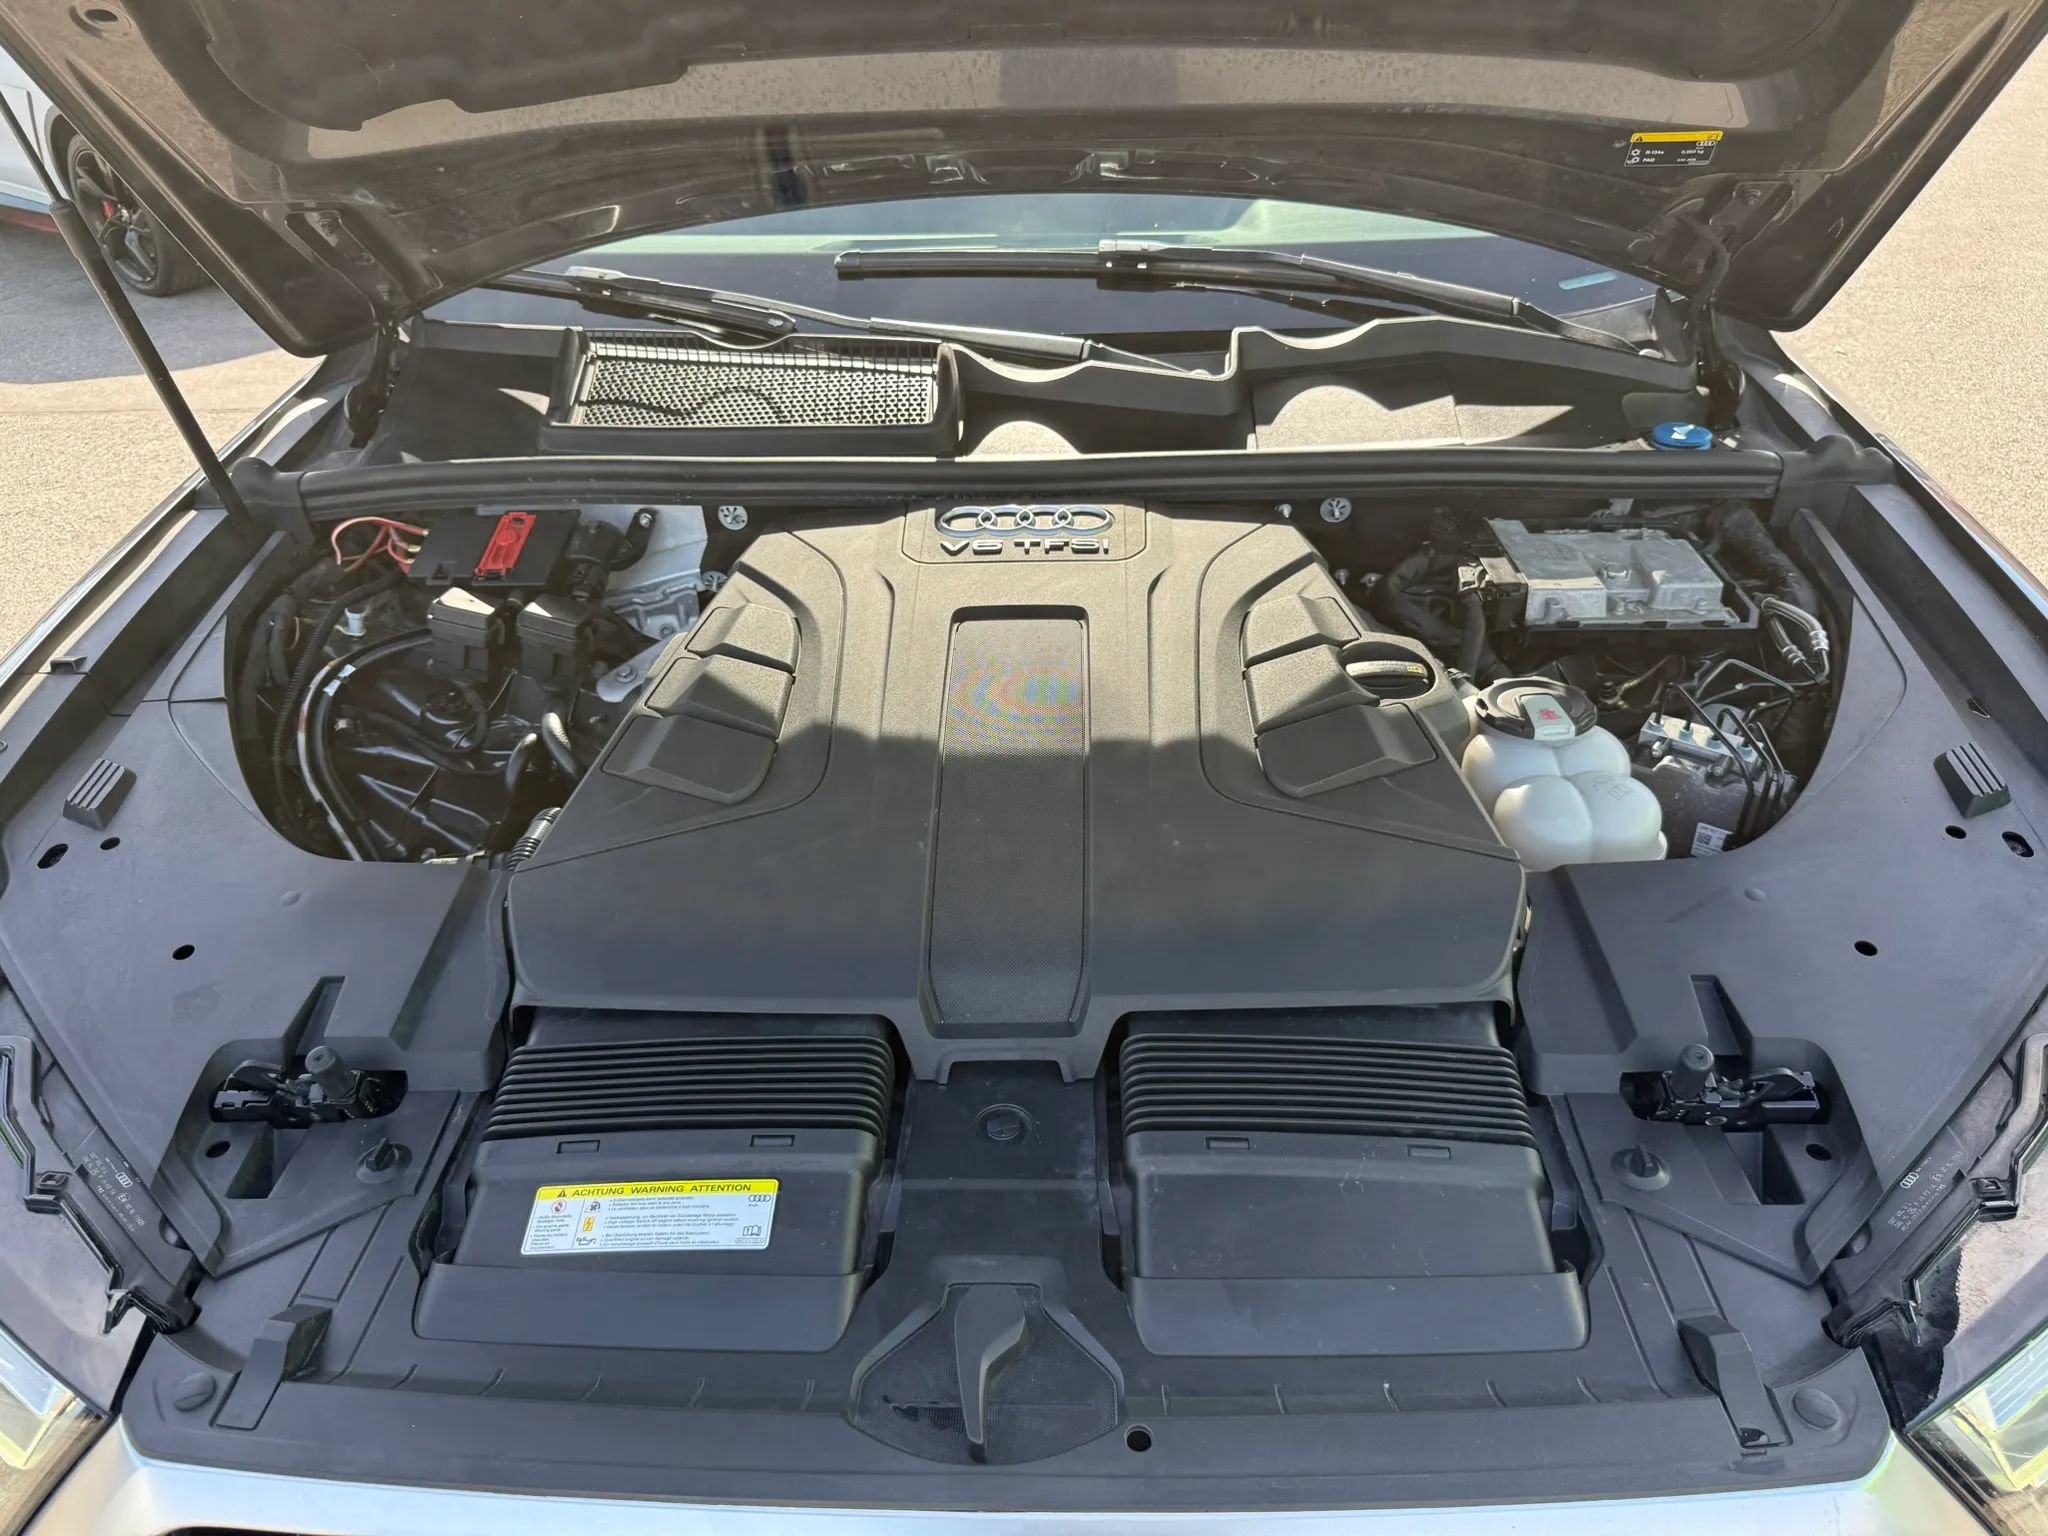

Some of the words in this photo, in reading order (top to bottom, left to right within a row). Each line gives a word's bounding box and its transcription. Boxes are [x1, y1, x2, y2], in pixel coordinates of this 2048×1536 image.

[940, 539, 1003, 557] V6
[1014, 538, 1109, 555] TFSI
[572, 1187, 624, 1198] ACHTUNG
[631, 1185, 684, 1194] WARNING
[690, 1183, 751, 1193] ATTENTION
